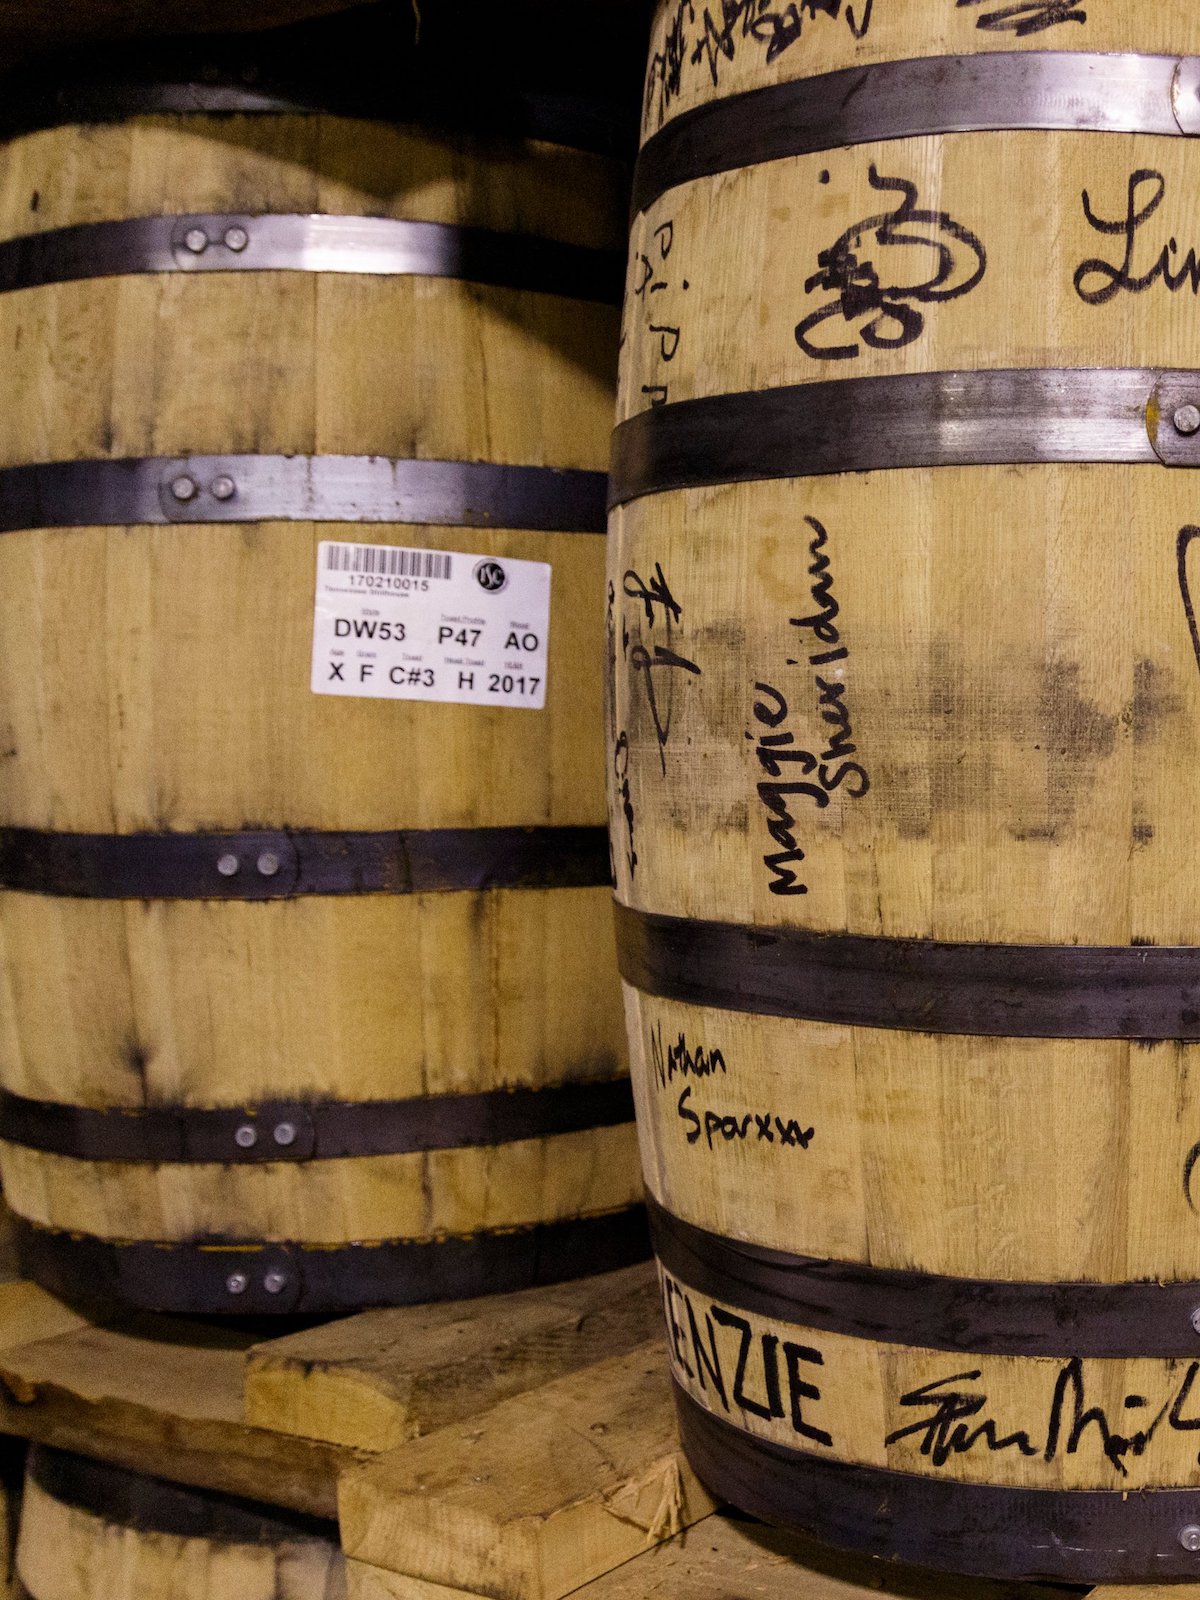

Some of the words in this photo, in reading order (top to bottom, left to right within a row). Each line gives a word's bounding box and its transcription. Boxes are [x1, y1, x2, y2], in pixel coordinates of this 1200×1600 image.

[349, 575, 430, 592] 170210015
[334, 618, 406, 641] DW53
[438, 626, 482, 647] P47
[328, 662, 345, 682] X
[360, 664, 374, 683] F
[389, 666, 435, 687] C#3
[458, 671, 475, 690] H
[488, 674, 540, 695] 2017
[744, 681, 830, 896] Maggie
